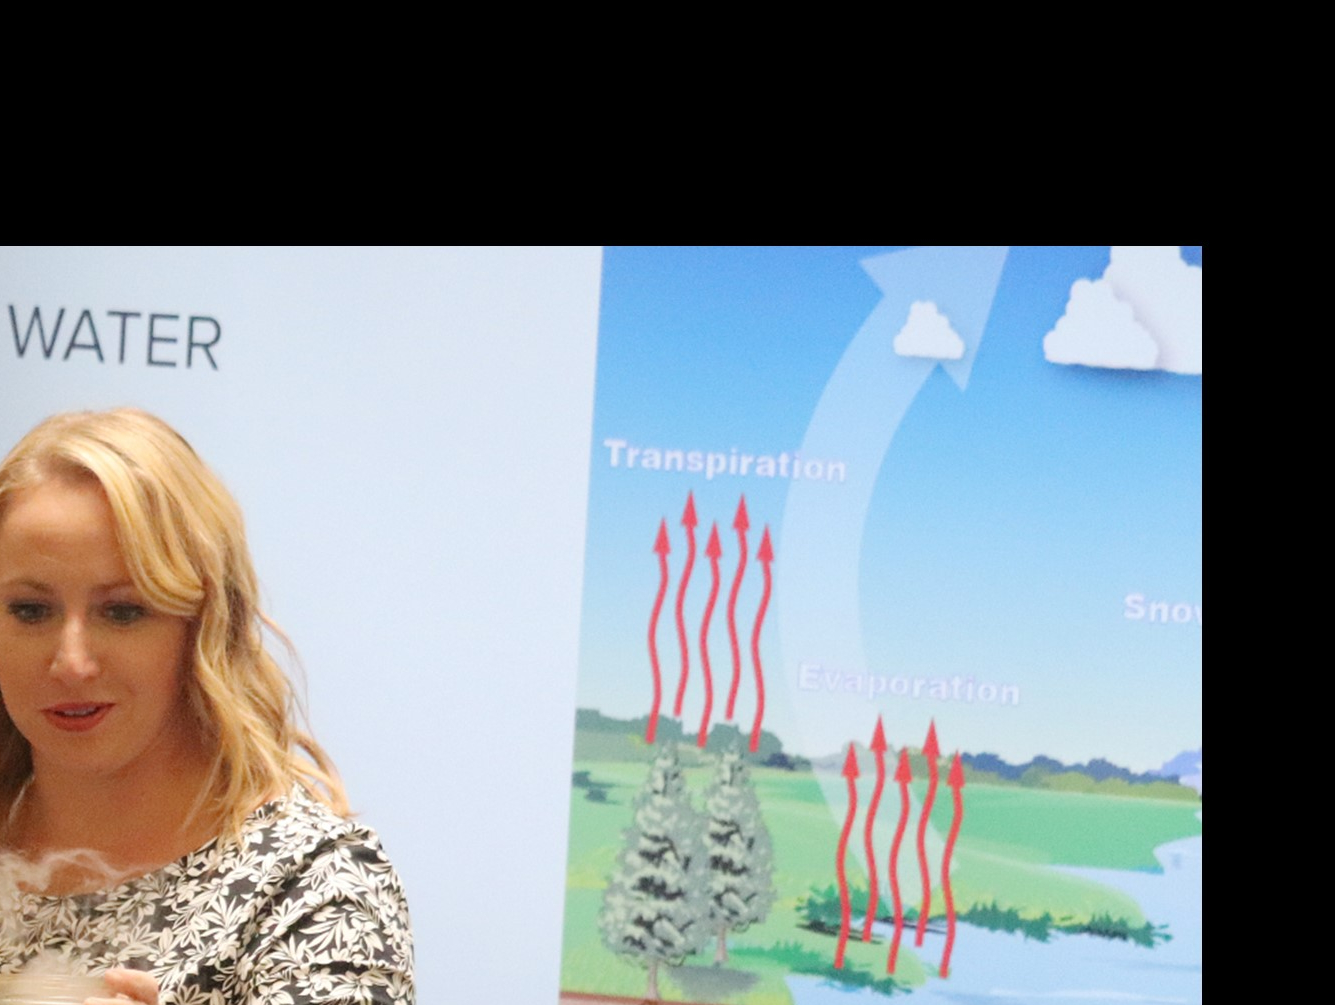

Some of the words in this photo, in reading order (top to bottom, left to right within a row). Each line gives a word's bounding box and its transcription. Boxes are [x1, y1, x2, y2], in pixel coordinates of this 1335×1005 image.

[7, 304, 222, 371] WATER
[603, 437, 847, 483] Transpiration
[797, 662, 1021, 706] Evaporation
